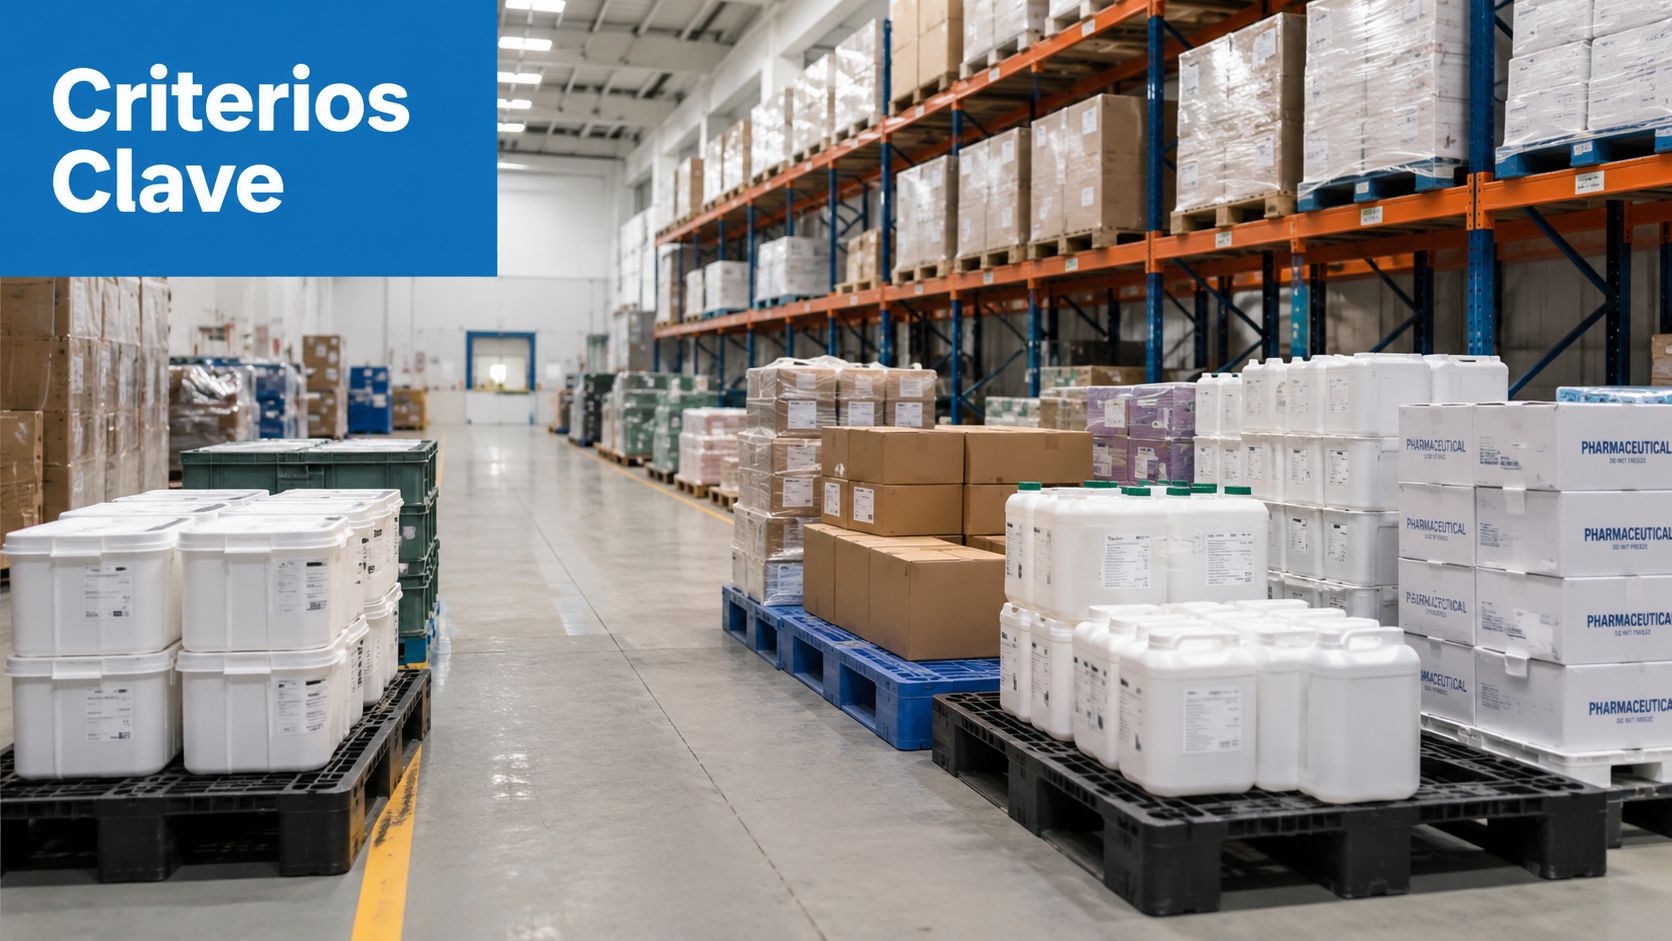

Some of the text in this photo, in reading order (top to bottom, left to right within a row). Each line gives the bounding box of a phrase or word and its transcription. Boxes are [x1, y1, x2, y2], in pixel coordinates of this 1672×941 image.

[1406, 438, 1467, 453] PHARMACEUTICAL
[1581, 440, 1672, 455] PHARMACEUTICAL
[1587, 611, 1672, 628] PHARMACEUTICA
[1589, 698, 1672, 716] PHARMACEUTICA
